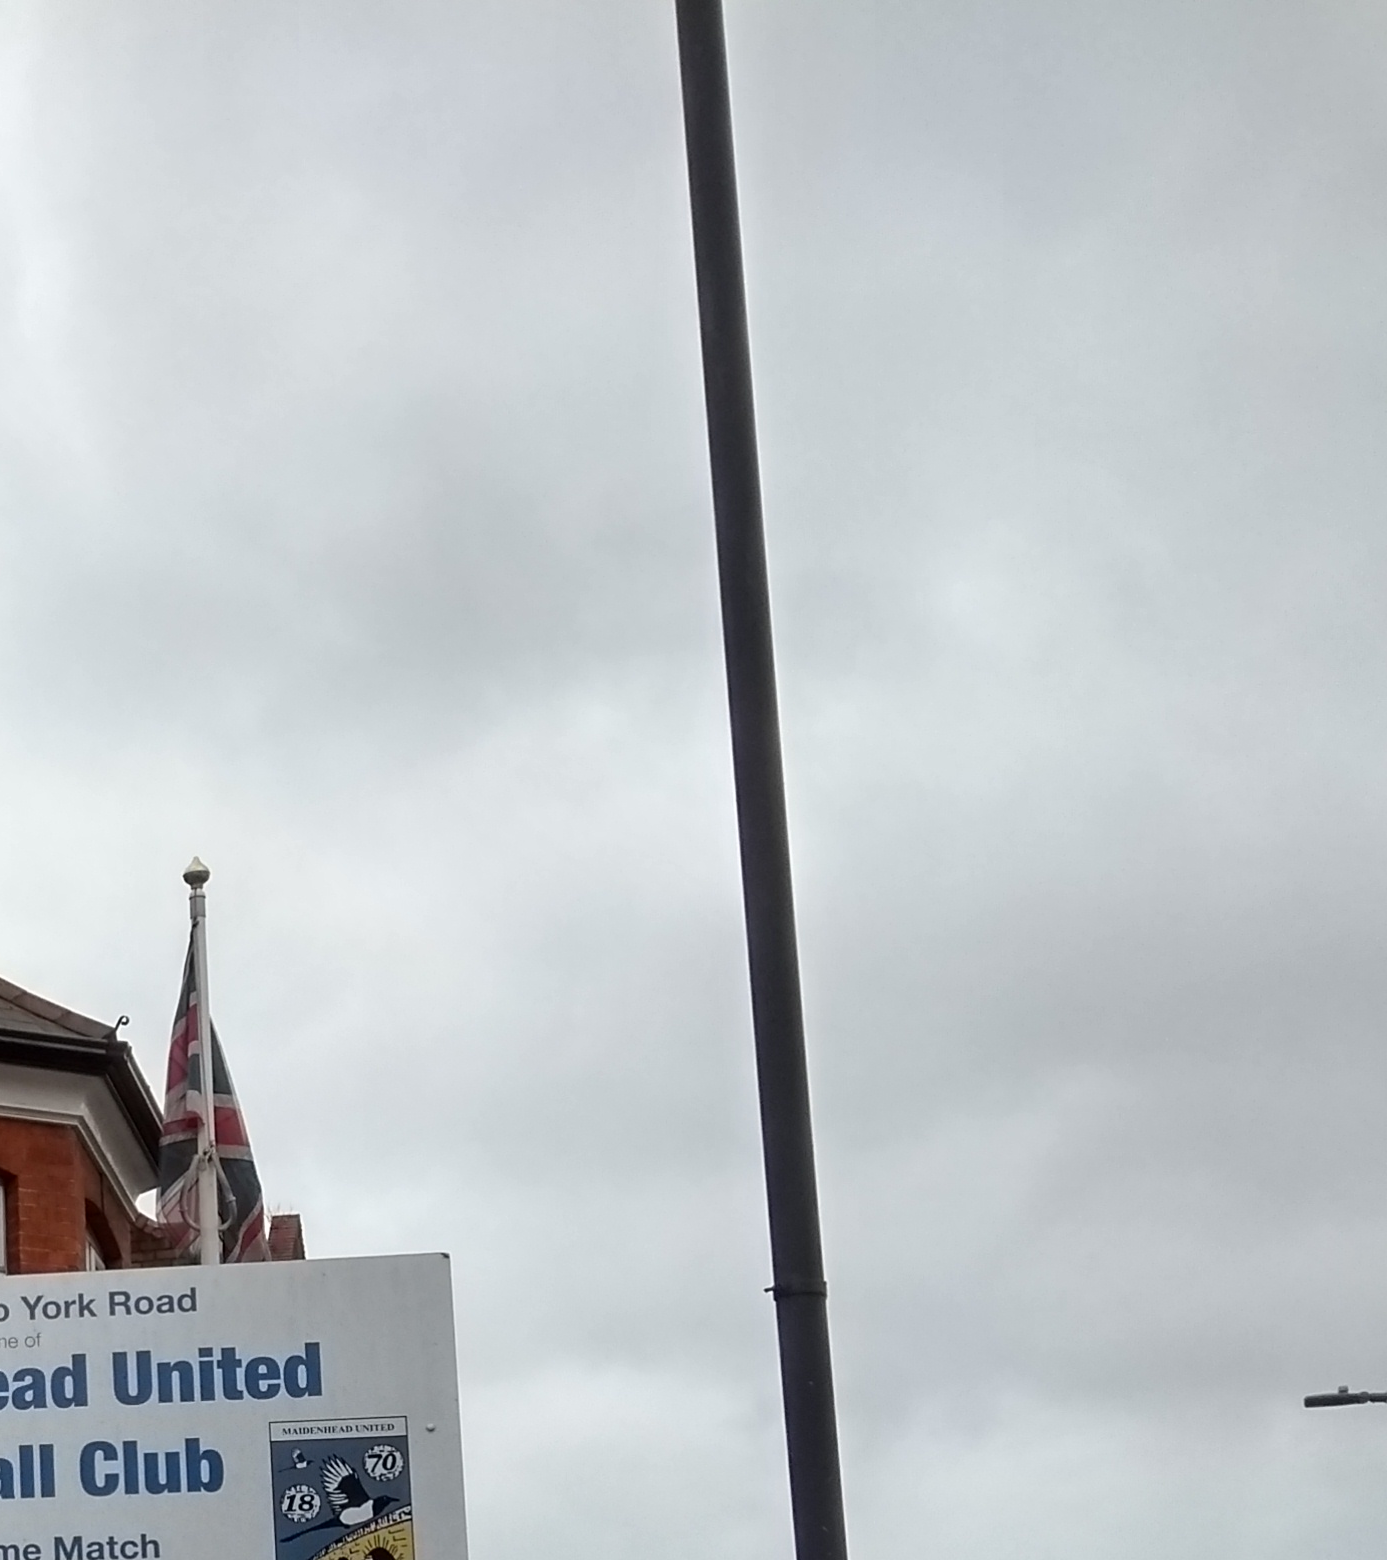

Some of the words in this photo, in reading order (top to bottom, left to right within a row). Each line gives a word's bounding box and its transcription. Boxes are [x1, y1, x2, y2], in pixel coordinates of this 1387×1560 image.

[21, 1292, 97, 1321] York
[109, 1287, 198, 1316] Road
[24, 1332, 42, 1348] of
[112, 1342, 323, 1406] United
[282, 1425, 353, 1436] MAIDENHEAD
[355, 1424, 395, 1433] UNITED
[79, 1438, 225, 1497] Club
[368, 1453, 397, 1473] 70
[285, 1494, 315, 1512] 18
